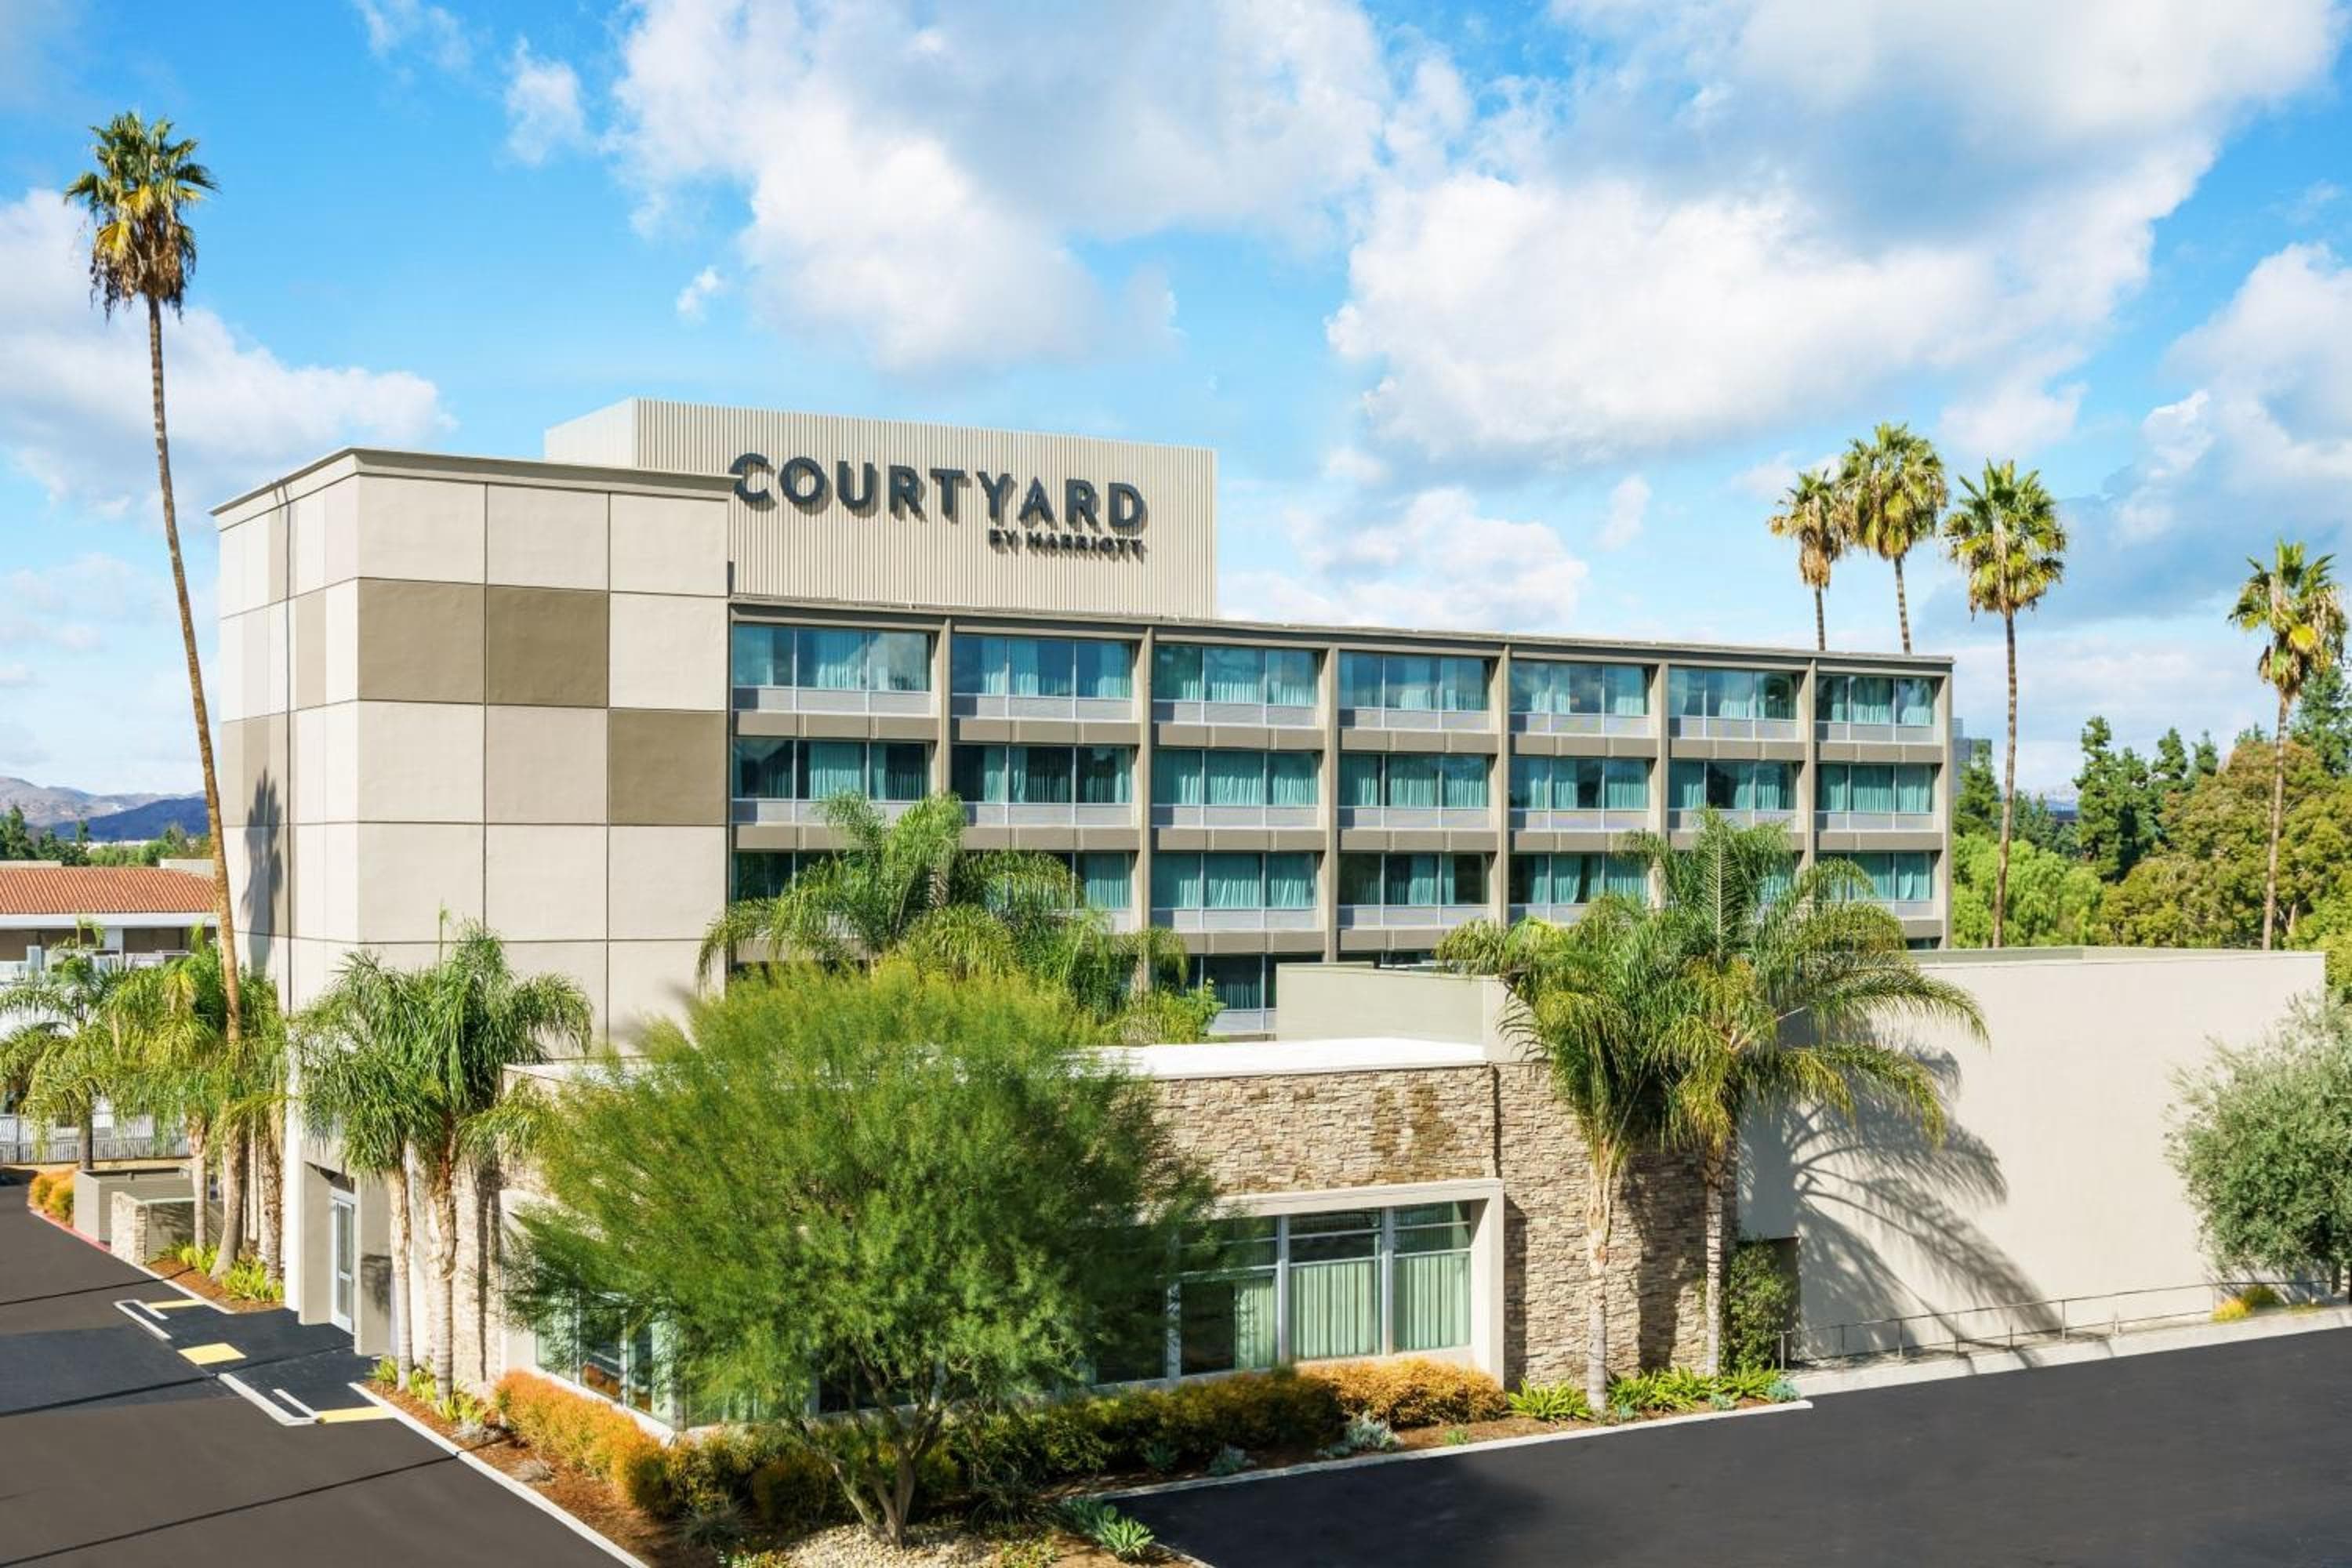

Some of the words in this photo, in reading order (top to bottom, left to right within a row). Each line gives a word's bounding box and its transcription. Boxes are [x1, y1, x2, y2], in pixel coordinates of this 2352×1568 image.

[729, 452, 1146, 529] COURTYARD
[989, 528, 1018, 550] BY
[1027, 531, 1144, 554] MARRIOTT
